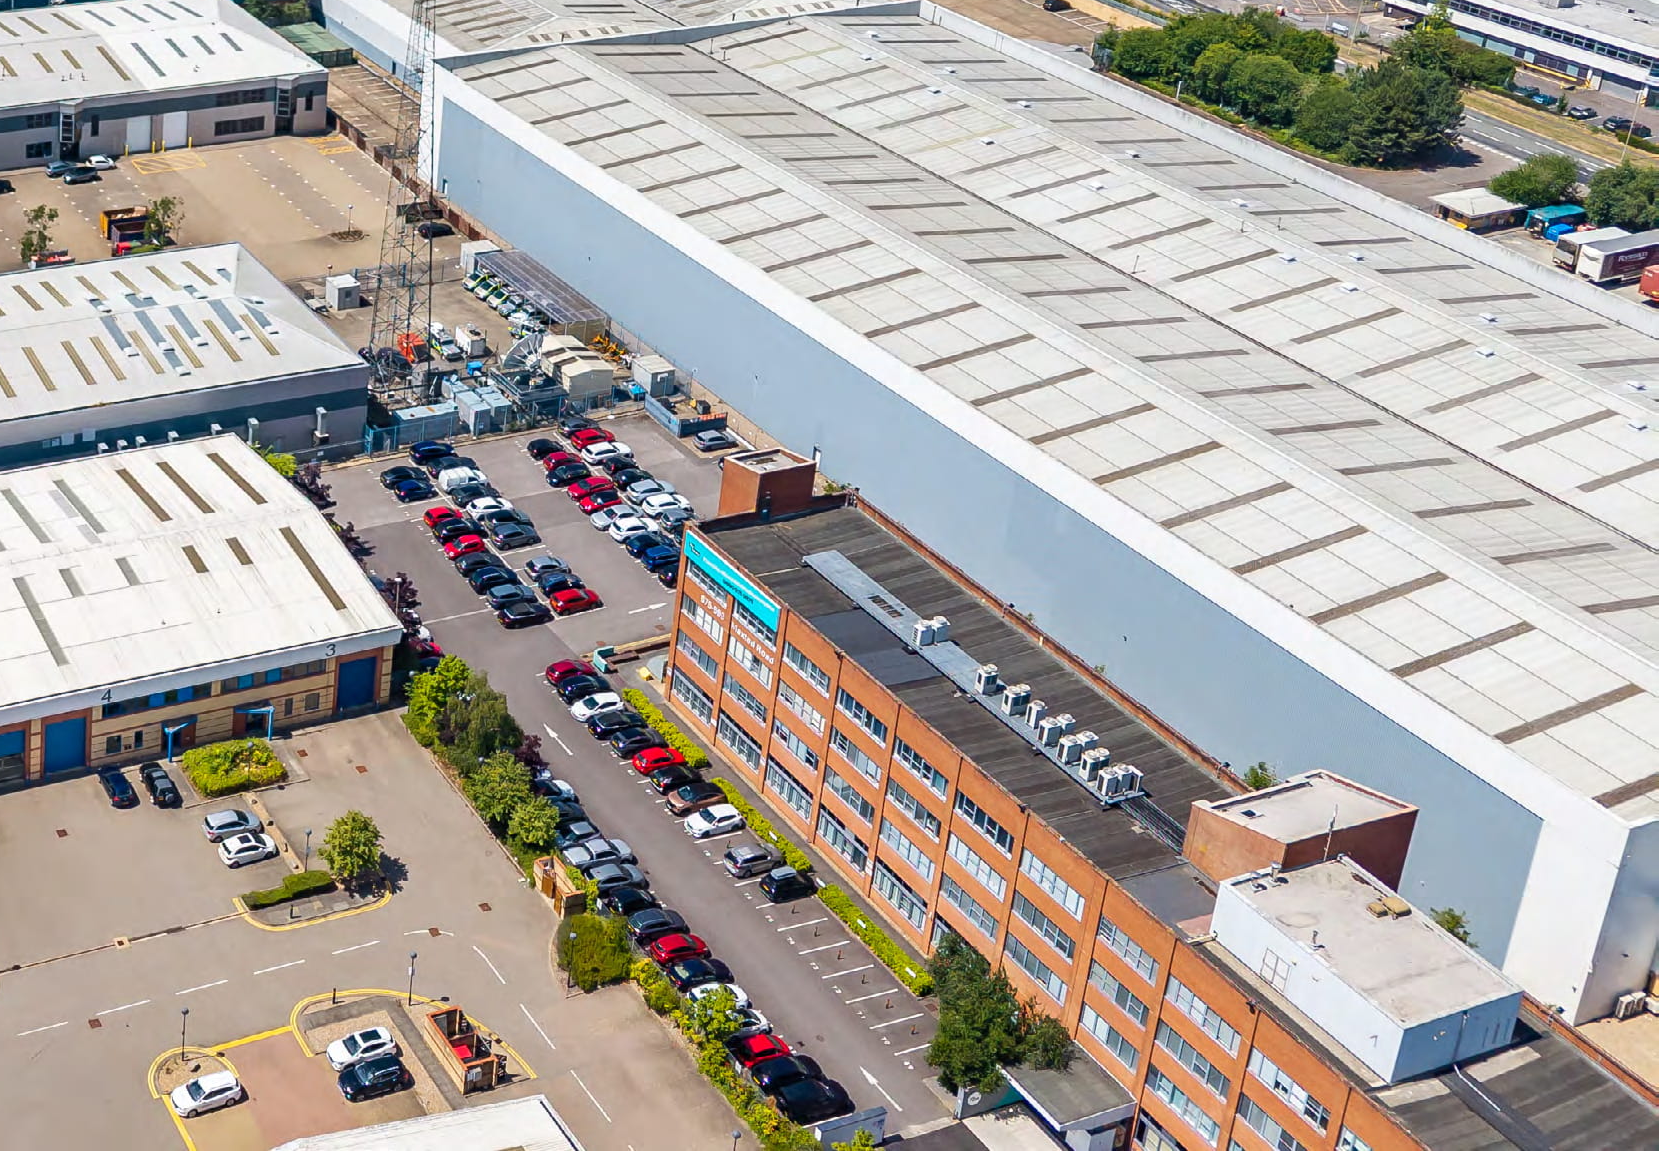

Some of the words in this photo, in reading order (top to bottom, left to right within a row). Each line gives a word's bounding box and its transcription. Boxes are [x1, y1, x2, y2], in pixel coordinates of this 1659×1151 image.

[731, 621, 756, 649] Maxted
[755, 645, 774, 664] Road
[325, 643, 336, 657] 3
[101, 689, 113, 702] 4
